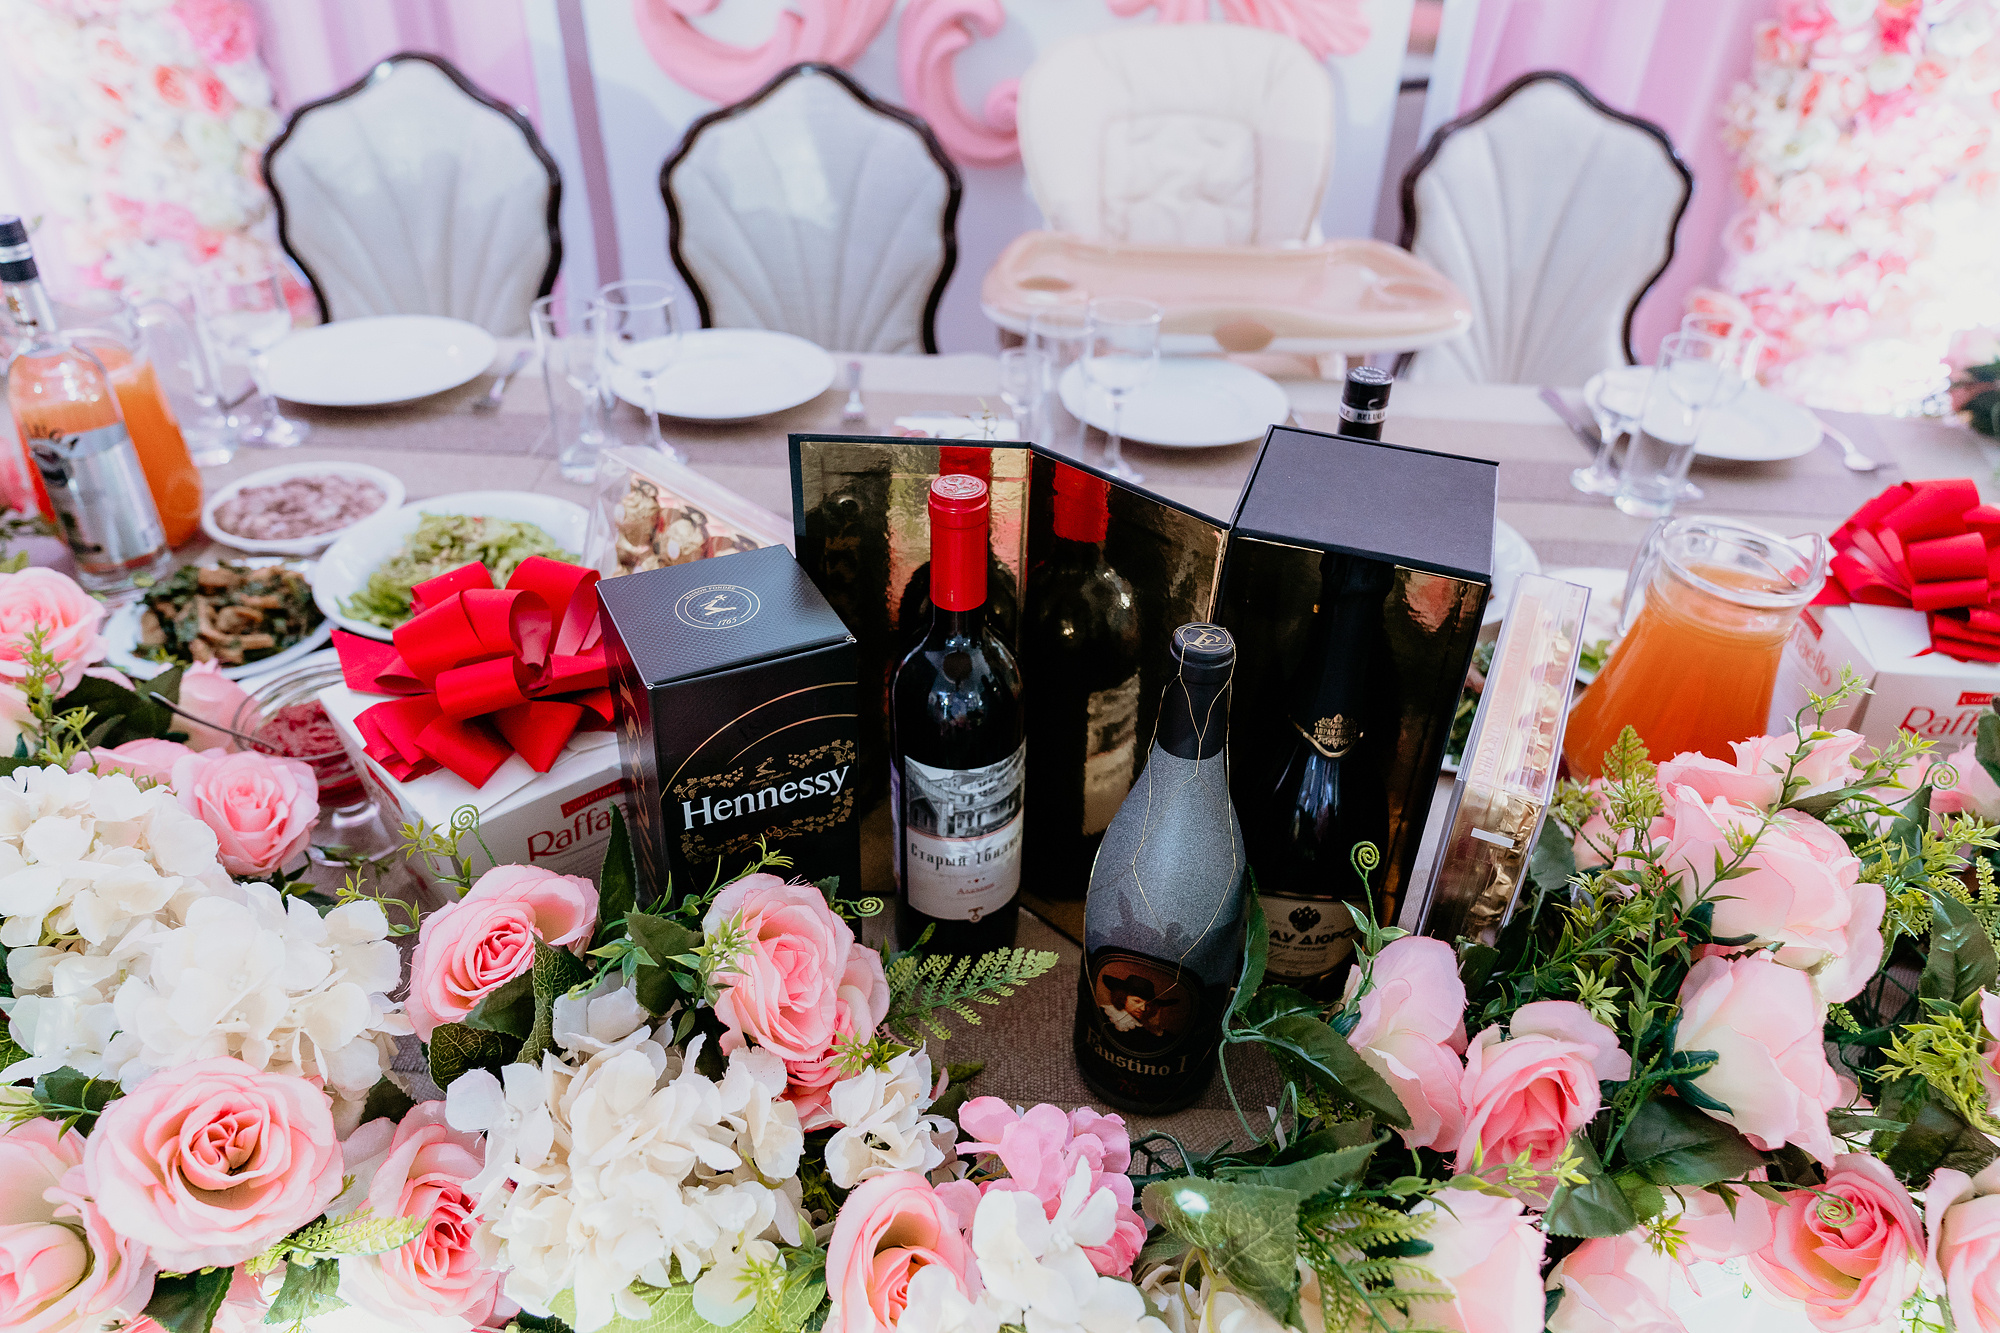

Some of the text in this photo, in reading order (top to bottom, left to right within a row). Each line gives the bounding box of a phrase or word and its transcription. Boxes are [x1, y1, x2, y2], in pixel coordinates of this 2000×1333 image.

[717, 616, 738, 627] 1765
[1899, 706, 1979, 739] Raff
[681, 765, 851, 830] Hennessy
[910, 842, 967, 871] Старый
[1086, 1024, 1193, 1076] Faustino I
